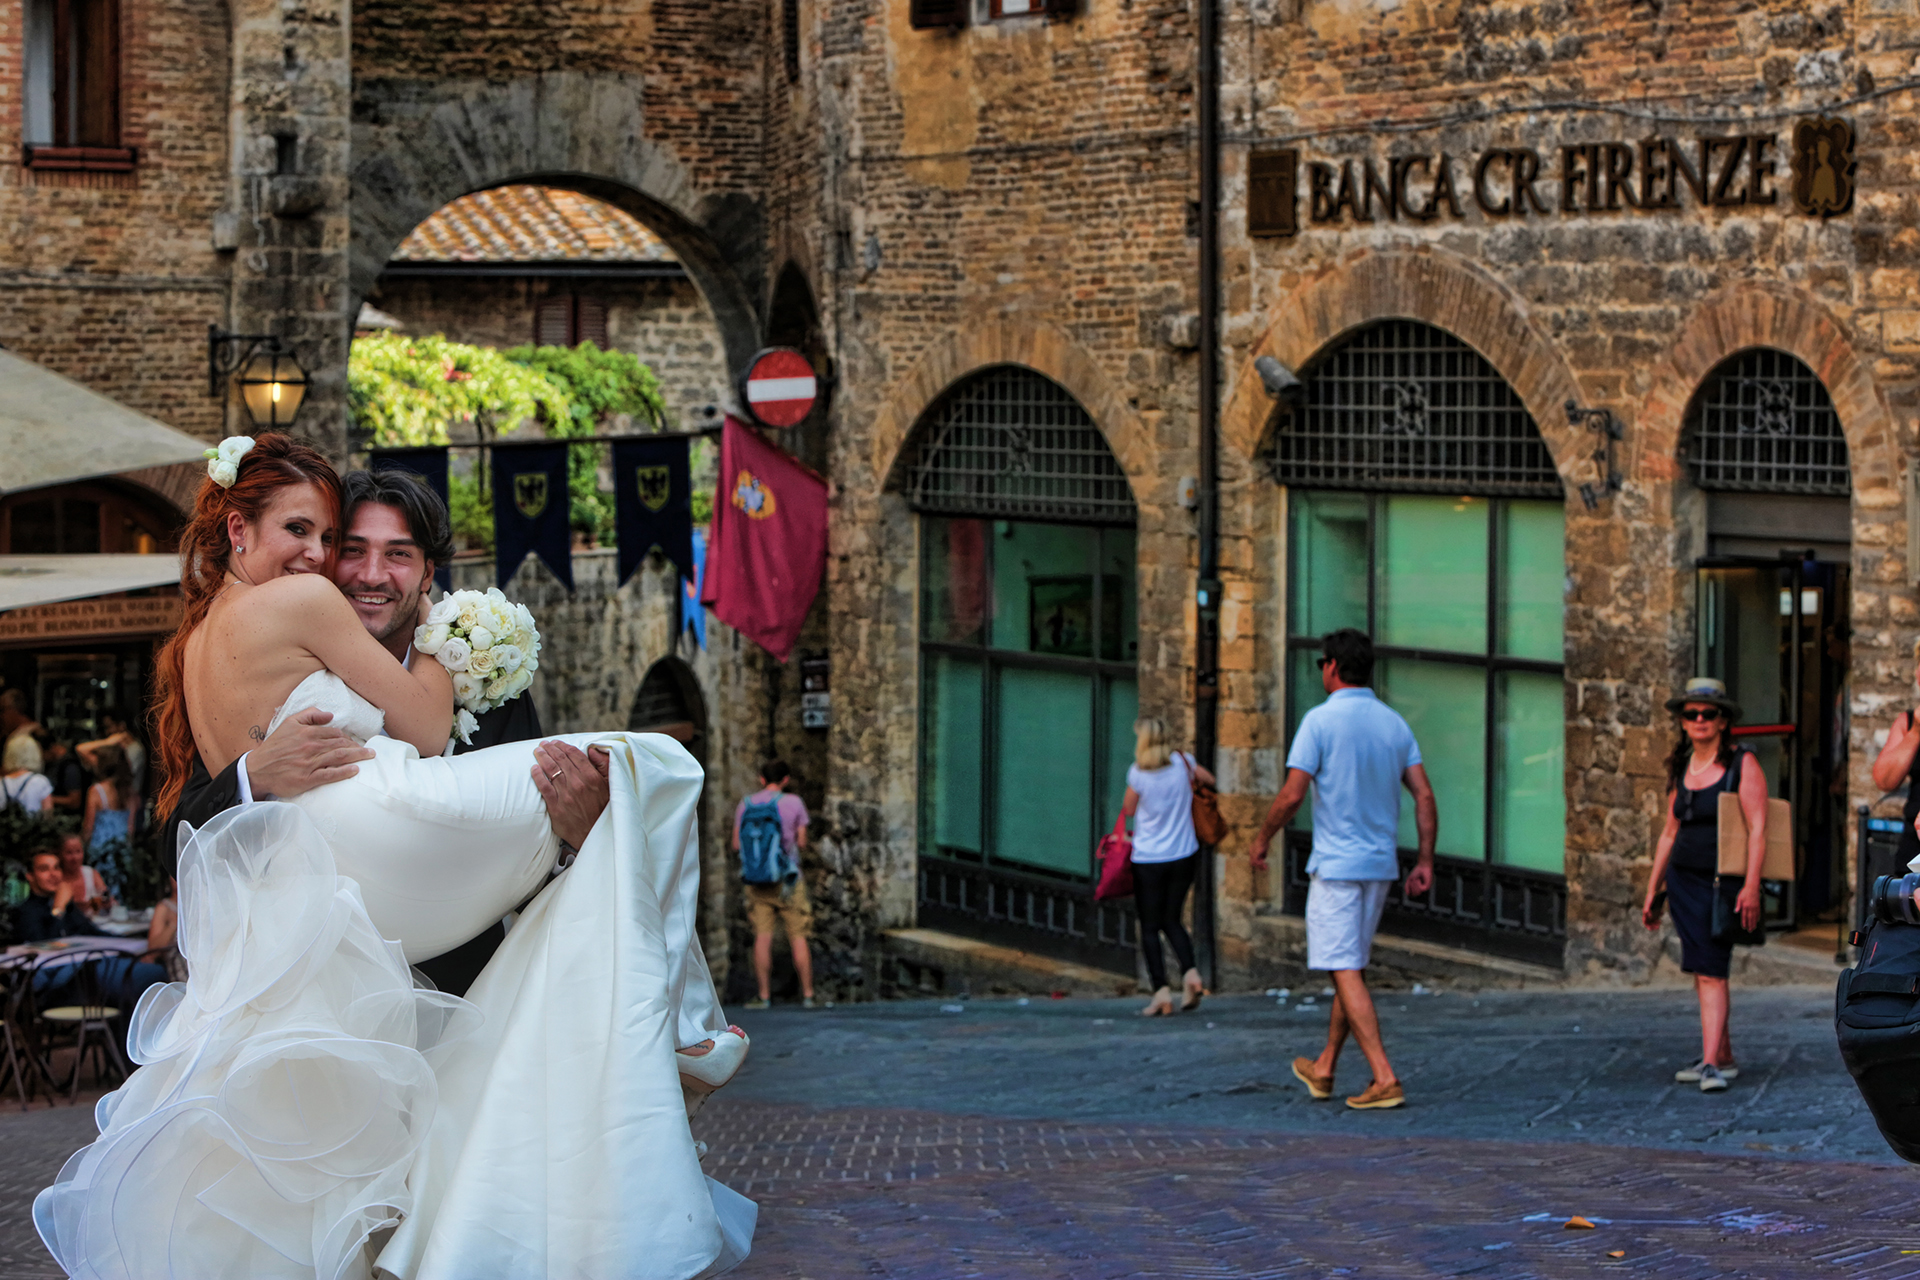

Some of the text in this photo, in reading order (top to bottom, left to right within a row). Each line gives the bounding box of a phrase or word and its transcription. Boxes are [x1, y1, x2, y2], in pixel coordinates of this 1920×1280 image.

[1308, 131, 1778, 223] BANCA CR FIRENZE
